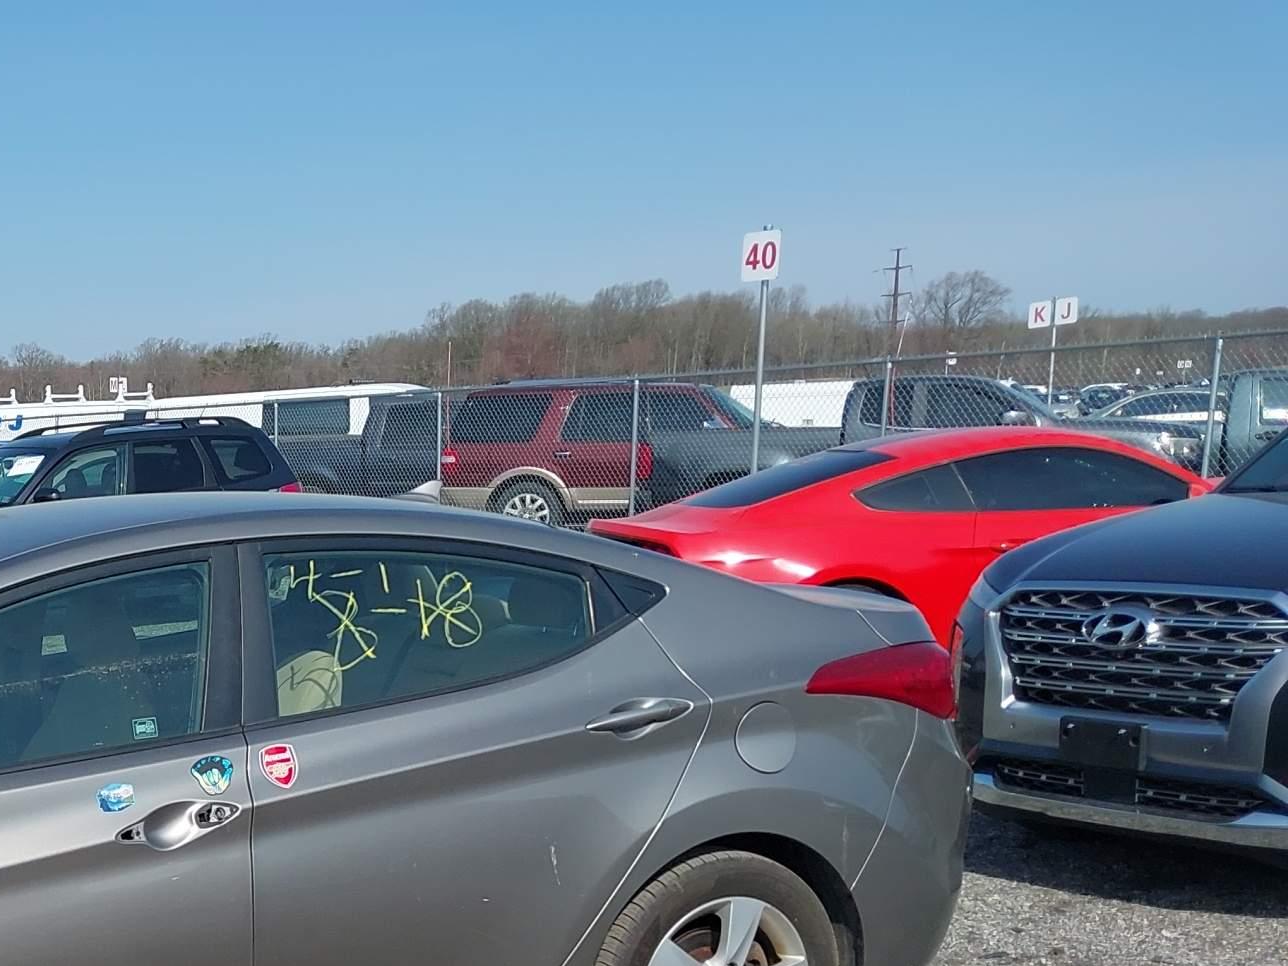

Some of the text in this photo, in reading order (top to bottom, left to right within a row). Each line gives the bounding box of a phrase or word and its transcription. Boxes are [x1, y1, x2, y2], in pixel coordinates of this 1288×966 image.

[745, 241, 777, 270] 40
[1034, 305, 1046, 323] K
[1061, 302, 1071, 319] J
